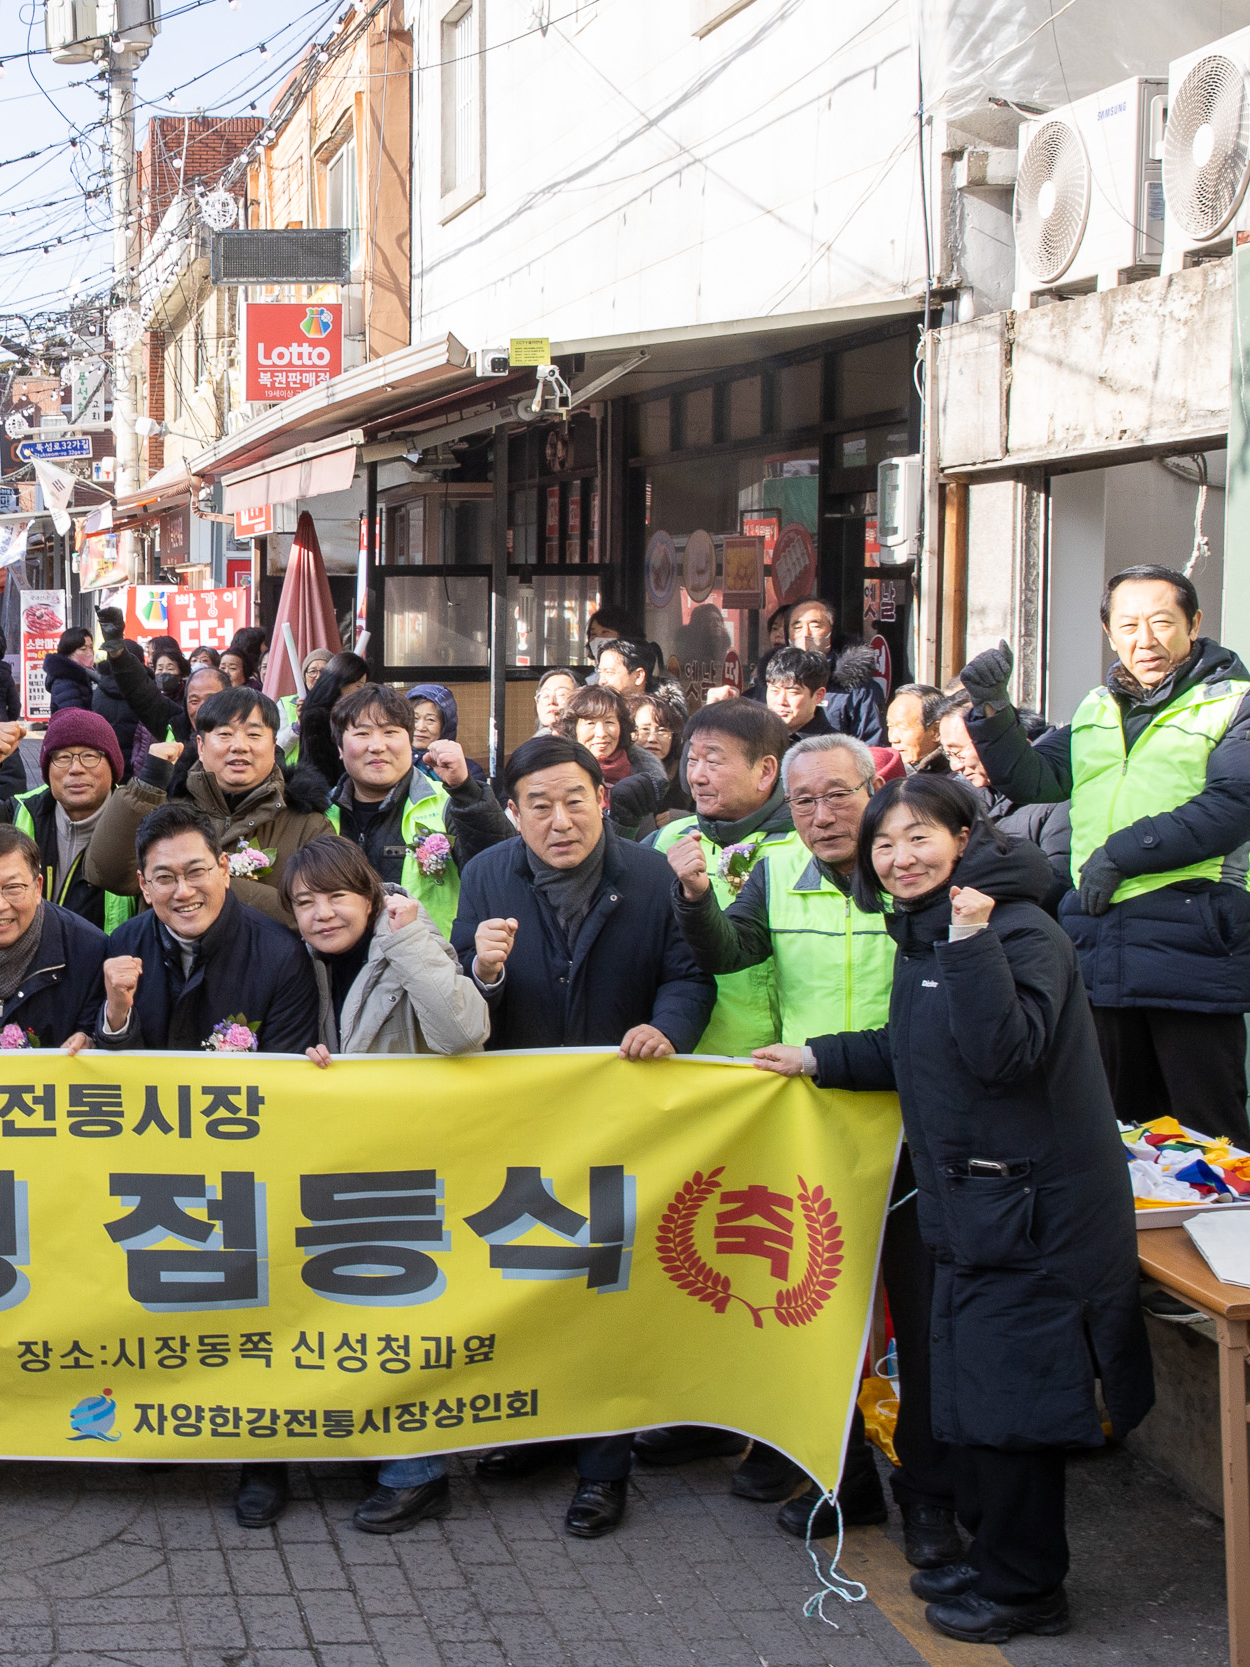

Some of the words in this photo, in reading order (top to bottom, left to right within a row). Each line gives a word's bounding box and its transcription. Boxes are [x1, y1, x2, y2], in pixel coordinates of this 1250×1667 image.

[1097, 101, 1127, 121] SAMSUNG
[258, 342, 330, 366] Lotto
[264, 389, 294, 398] 19세이상
[35, 439, 90, 452] 뚝섬로32가길
[175, 591, 238, 619] 빨강이
[864, 581, 896, 622] 옛날
[685, 660, 717, 701] 옛날
[102, 1164, 638, 1312] 점등식
[715, 1184, 794, 1282] 축
[16, 1331, 274, 1374] 장소:시장동쪽
[290, 1330, 497, 1374] 신성청과옆
[133, 1388, 540, 1440] 자양한강전통시장상인회
